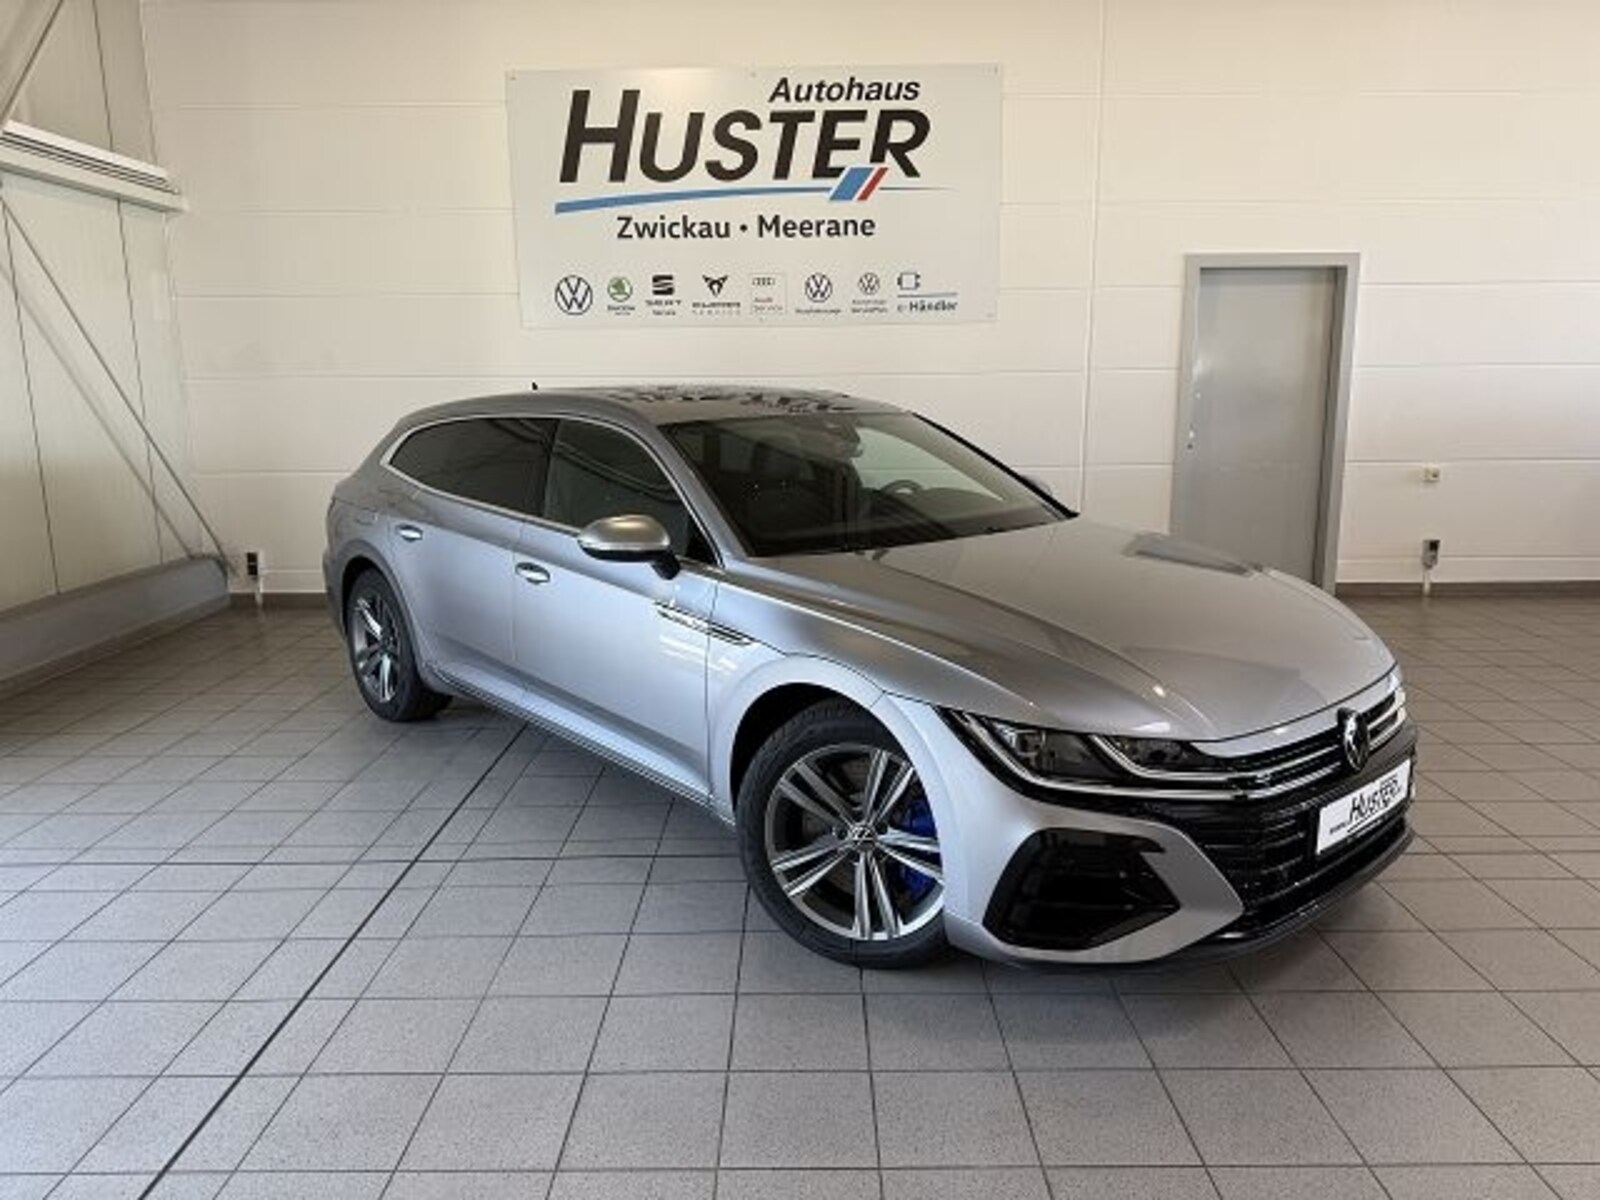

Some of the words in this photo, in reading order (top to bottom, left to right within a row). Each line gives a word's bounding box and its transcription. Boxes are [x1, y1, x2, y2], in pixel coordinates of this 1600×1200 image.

[768, 77, 920, 104] Autohaus
[559, 89, 931, 184] HUSTER
[616, 215, 731, 240] Zwickau
[758, 214, 876, 239] Meerane
